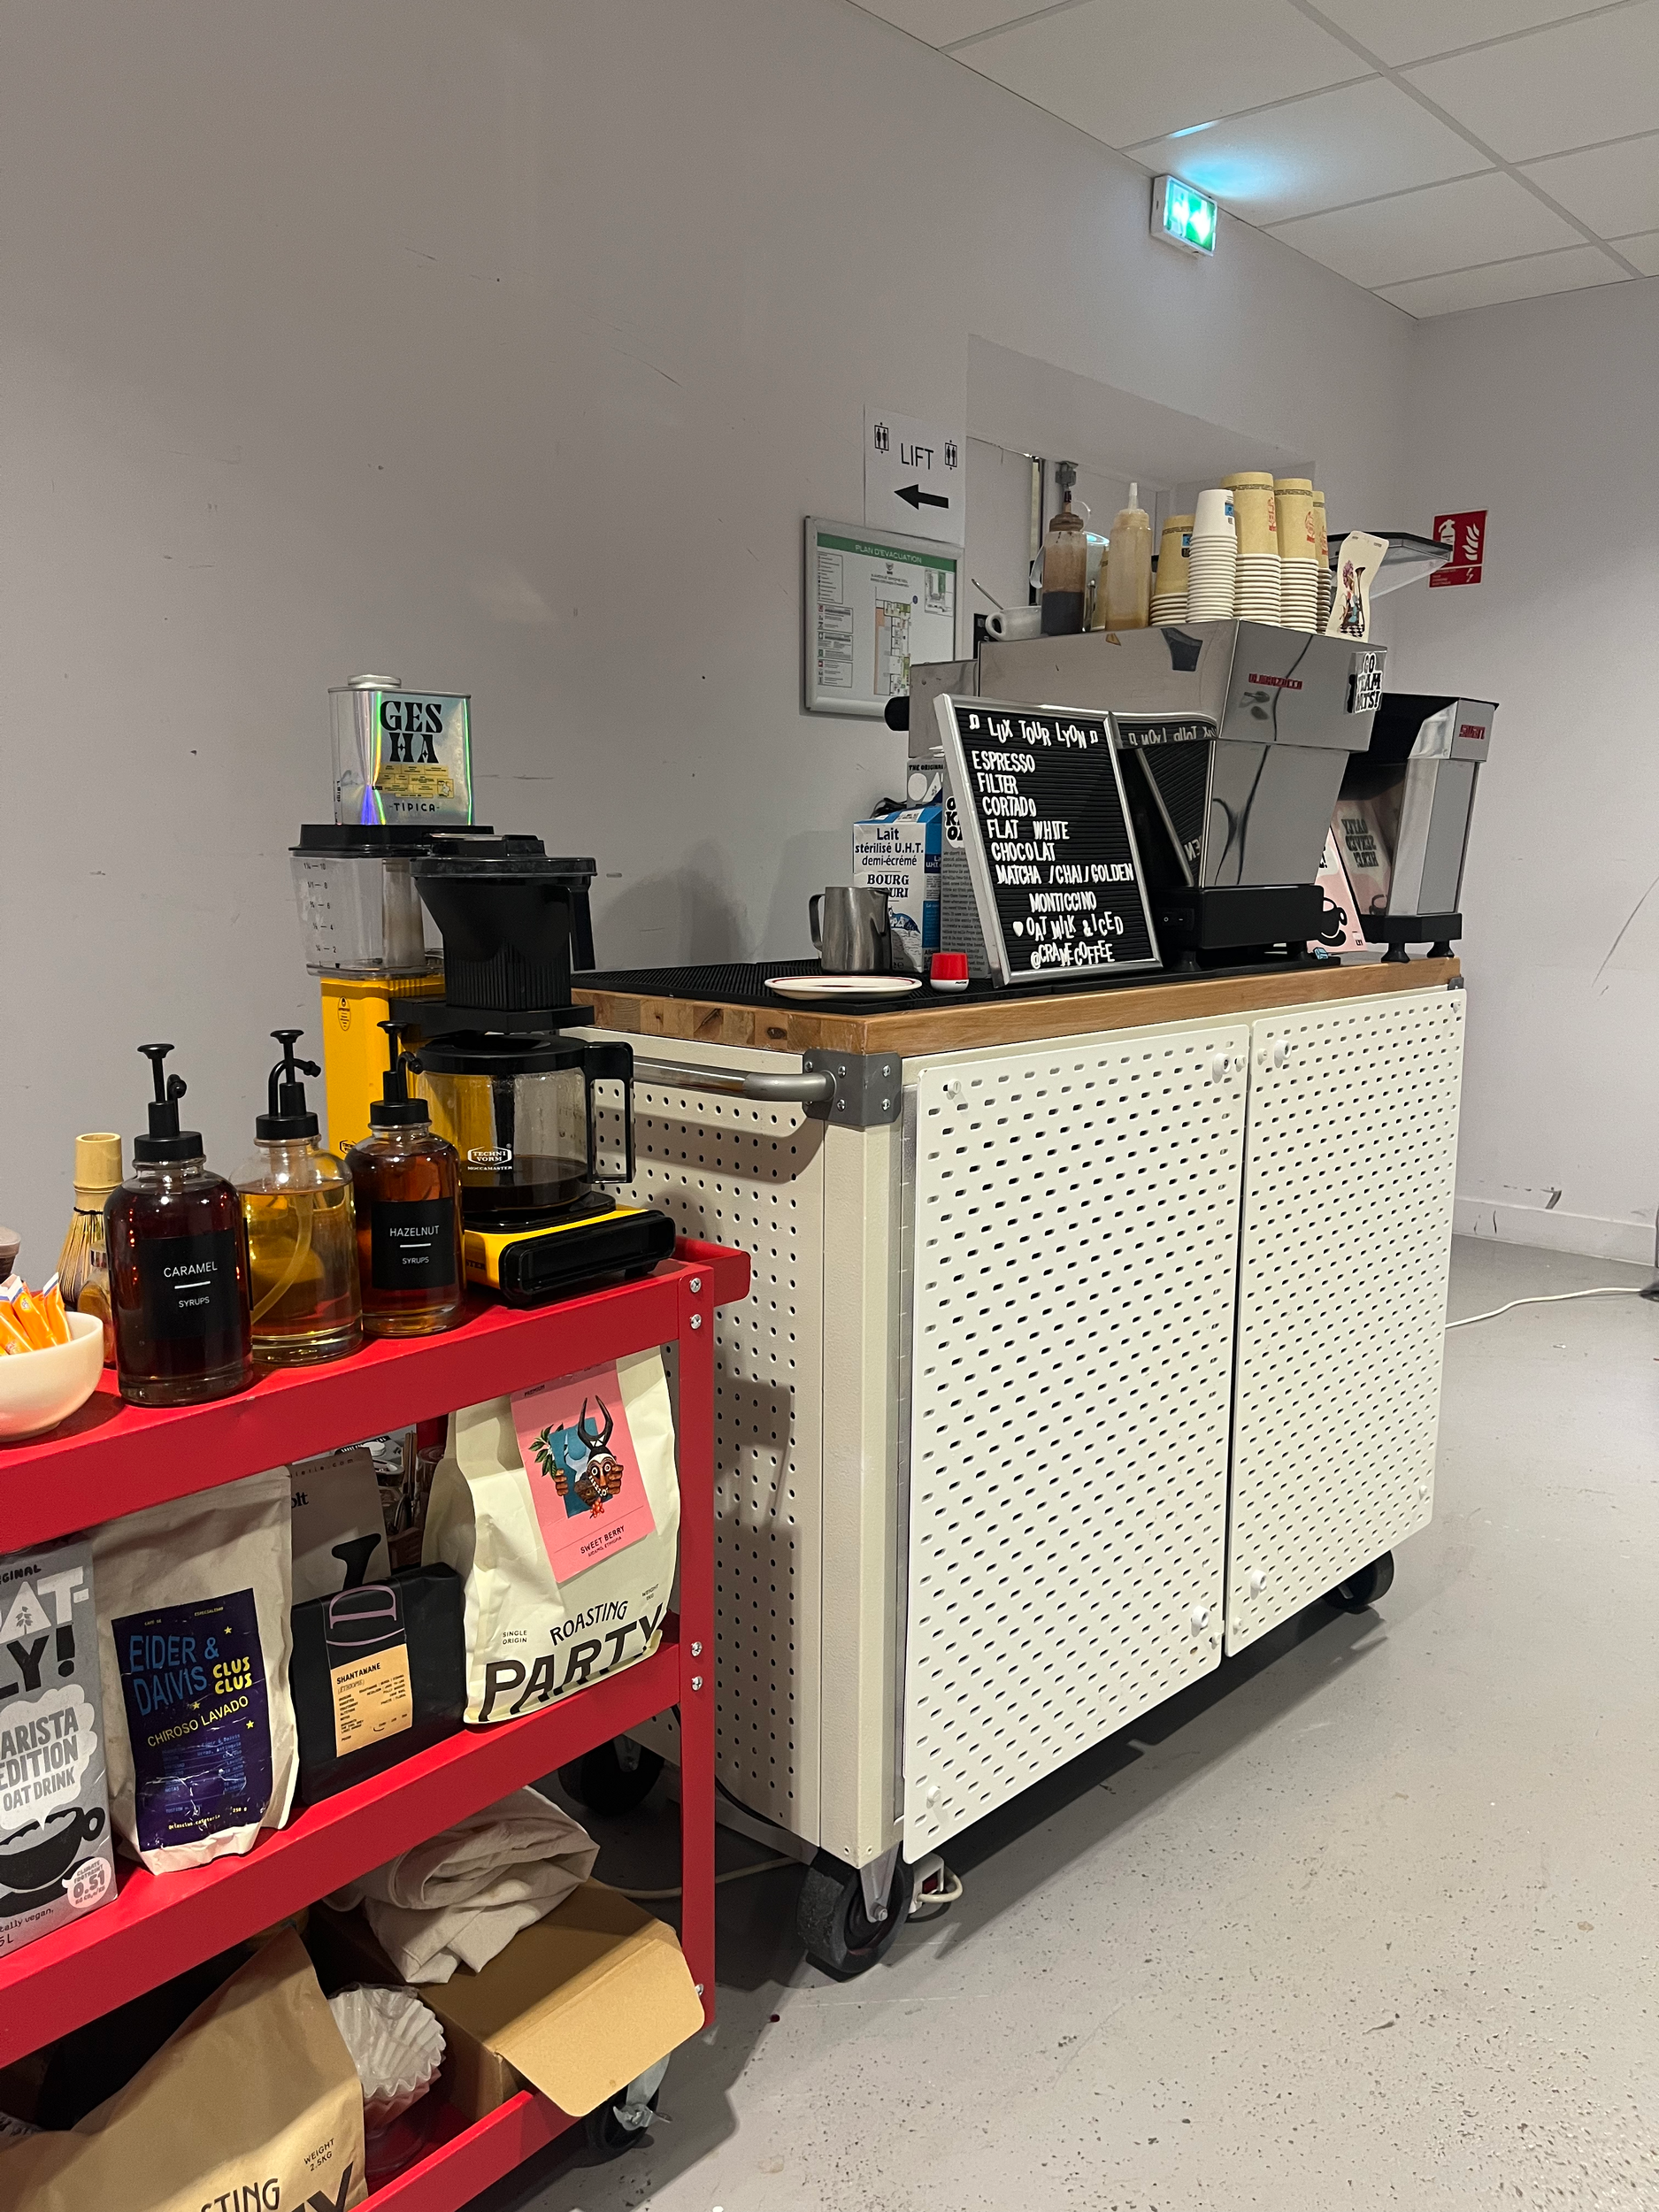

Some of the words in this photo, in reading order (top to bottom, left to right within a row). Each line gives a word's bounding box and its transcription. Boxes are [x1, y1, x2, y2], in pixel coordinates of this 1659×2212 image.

[900, 442, 934, 470] LIFT
[855, 544, 873, 555] PLAN
[874, 548, 922, 564] D'EVACUATION
[380, 700, 443, 733] GES
[987, 717, 1014, 744] LUX
[1018, 719, 1052, 747] TOUR
[1055, 721, 1087, 749] LYON
[388, 732, 439, 764] HA
[972, 750, 1036, 773] ESPRESSO
[976, 772, 1018, 795] FILTER
[982, 795, 1037, 818] CORTADO
[877, 828, 899, 841] Lait
[987, 818, 1018, 839] FLAT
[1033, 820, 1070, 840] WHITE
[855, 842, 892, 854] stérilisé
[895, 842, 924, 854] U.H.T.
[991, 841, 1056, 862] CHOCOLAT
[862, 855, 918, 867] demi-écrémé
[867, 873, 910, 886] BOURG
[995, 864, 1042, 885] MATCHA
[1028, 891, 1097, 913] MONTICCINO
[1026, 916, 1048, 941] OAT
[1050, 914, 1077, 941] MILK
[1091, 911, 1124, 936] ICED
[389, 1225, 440, 1237] HAZELNUT
[163, 1261, 218, 1278] CARAMEL
[178, 1296, 210, 1309] SYRUPS
[580, 1537, 603, 1554] SWEET
[603, 1525, 626, 1541] BERRY
[0, 1563, 42, 1584] GINAL
[549, 1600, 629, 1647] ROASTING
[129, 1635, 197, 1674] EIDER
[204, 1636, 219, 1660] &
[478, 1601, 664, 1723] PARTY
[212, 1655, 251, 1678] CLUS
[133, 1665, 208, 1717] DAIVIS
[214, 1672, 253, 1694] CLUS
[147, 1719, 198, 1747] CHIROSO
[200, 1695, 249, 1726] LAVADO
[0, 1734, 79, 1795] EDITION
[3, 1783, 33, 1812] OAT
[33, 1765, 75, 1801] DRINK
[73, 1863, 104, 1884] FOOTPRINT
[76, 1859, 101, 1877] CLIMATE
[73, 1869, 105, 1899] 0.51
[303, 2138, 335, 2165] WEIGHT
[310, 2150, 333, 2171] 2.5KG
